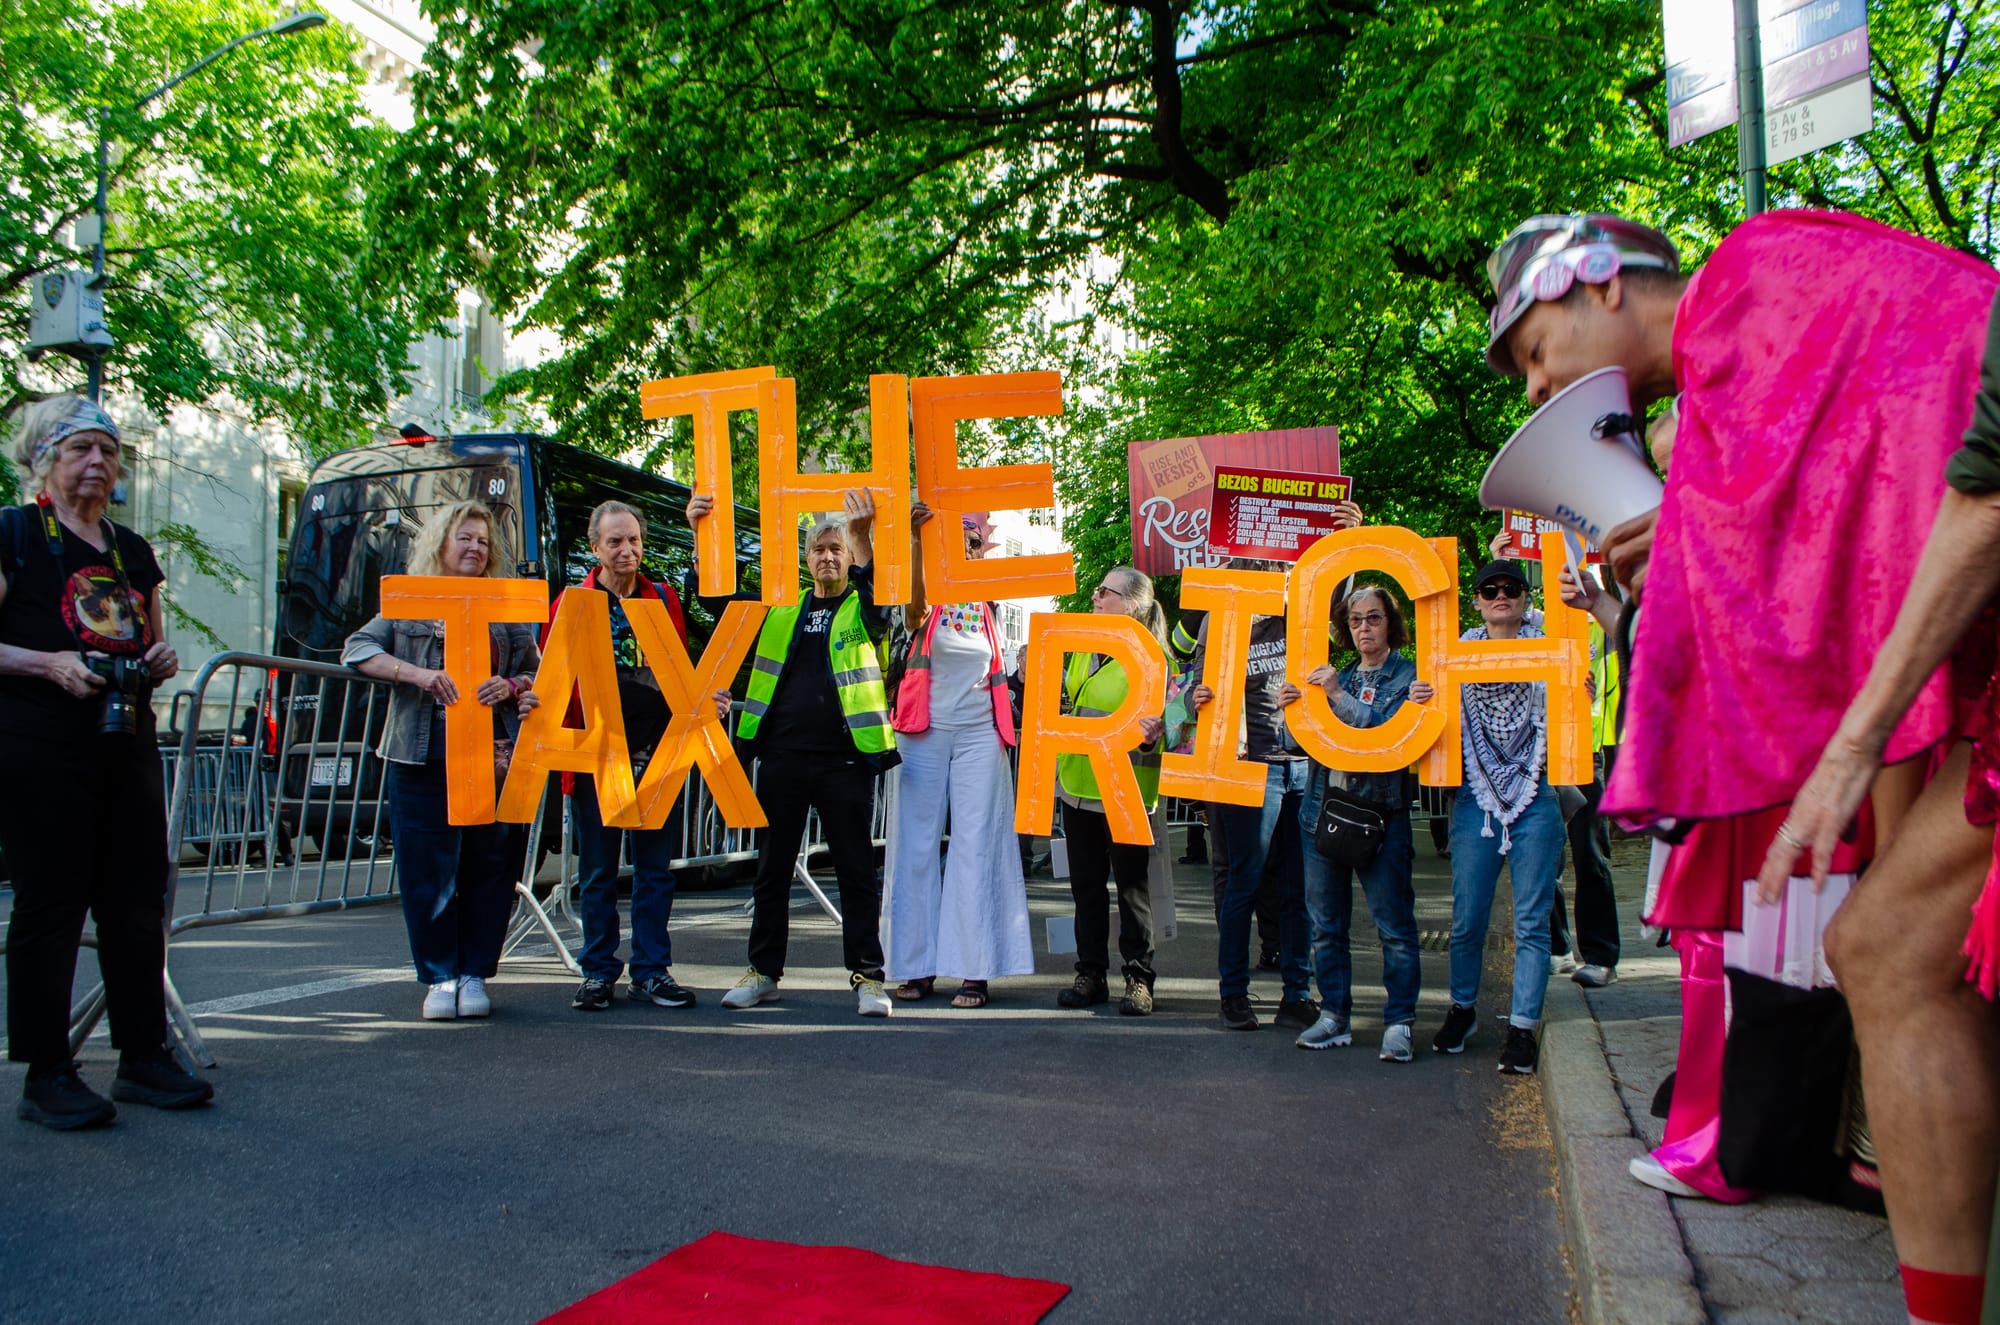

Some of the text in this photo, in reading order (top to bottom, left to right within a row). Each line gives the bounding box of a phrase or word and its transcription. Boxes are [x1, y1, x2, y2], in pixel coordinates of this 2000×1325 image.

[1830, 44, 1838, 60] 5
[1841, 38, 1858, 56] Av
[1770, 105, 1810, 131] 5 Av &
[1771, 121, 1815, 149] E 79 St
[1149, 444, 1196, 474] RISE AND
[1154, 455, 1200, 489] RESIST
[1187, 471, 1206, 491] .org
[489, 478, 506, 495] 80
[641, 366, 1076, 607] THE
[1217, 473, 1347, 499] BEZOS BUCKET LIST
[312, 495, 325, 511] 80
[1239, 496, 1336, 512] DESTROY SMALL BUSINESSES
[1239, 504, 1280, 516] UNION BUST
[1139, 496, 1211, 549] Res
[1237, 520, 1254, 530] RUIN
[1255, 521, 1268, 531] THE
[1269, 523, 1315, 535] WASHINGTON
[1238, 512, 1308, 526] PARTY WITH EPSTEIN
[1510, 515, 1533, 533] ARE
[1235, 536, 1299, 549] BUY THE MET GALA
[1236, 528, 1298, 541] COLLUDE WITH ICE
[1521, 533, 1536, 549] OF
[1015, 525, 1595, 847] RICH
[380, 575, 770, 831] TAX
